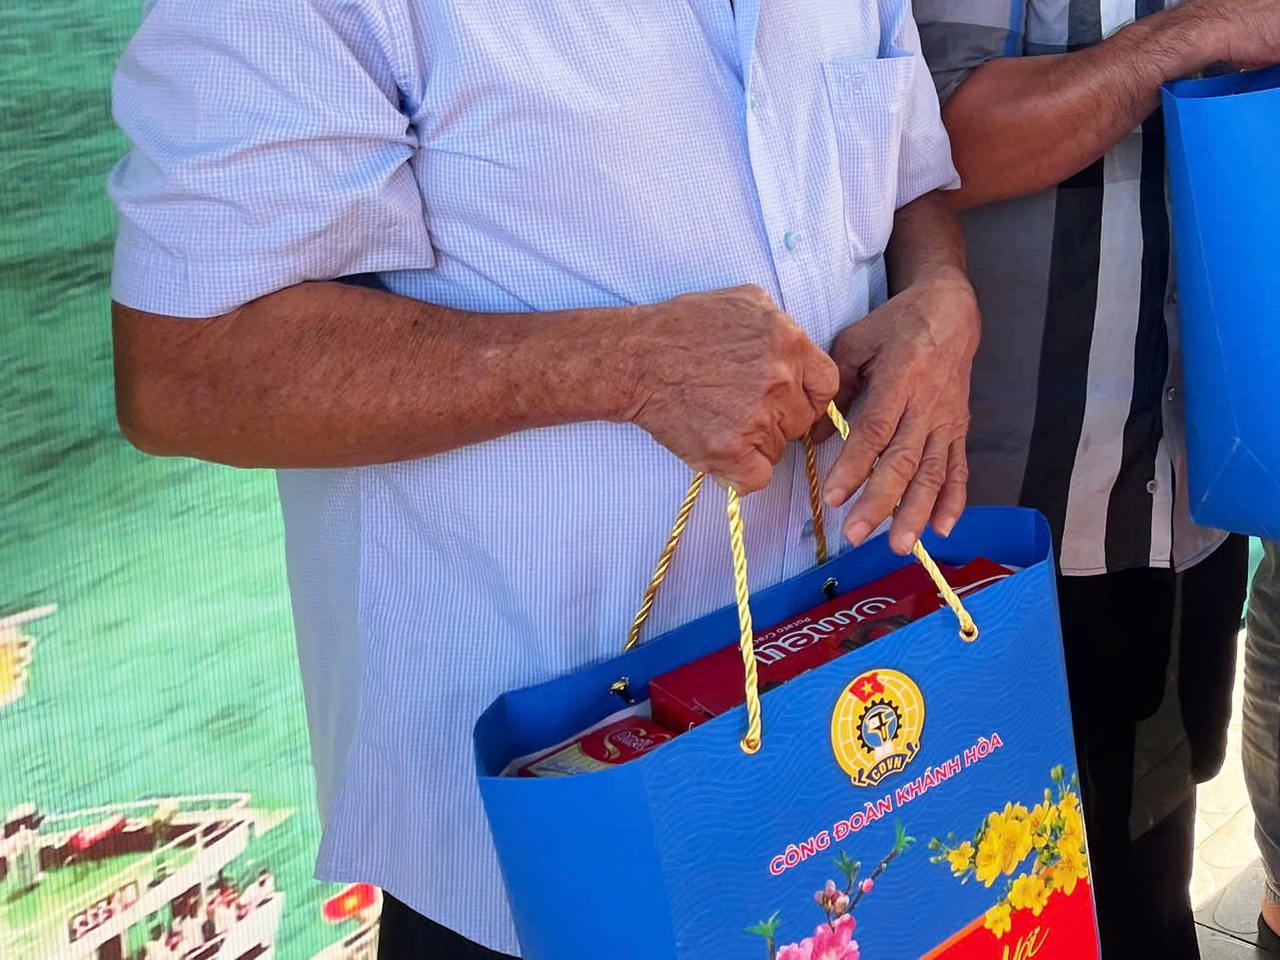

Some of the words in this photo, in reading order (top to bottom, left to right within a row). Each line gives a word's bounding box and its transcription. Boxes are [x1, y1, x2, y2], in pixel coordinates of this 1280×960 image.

[776, 616, 812, 633] Potato
[738, 631, 777, 652] Cracr
[769, 830, 831, 876] CÔNG
[833, 793, 894, 842] ĐOÀN
[895, 754, 962, 808] KHÁNH
[963, 732, 1004, 769] HÒA
